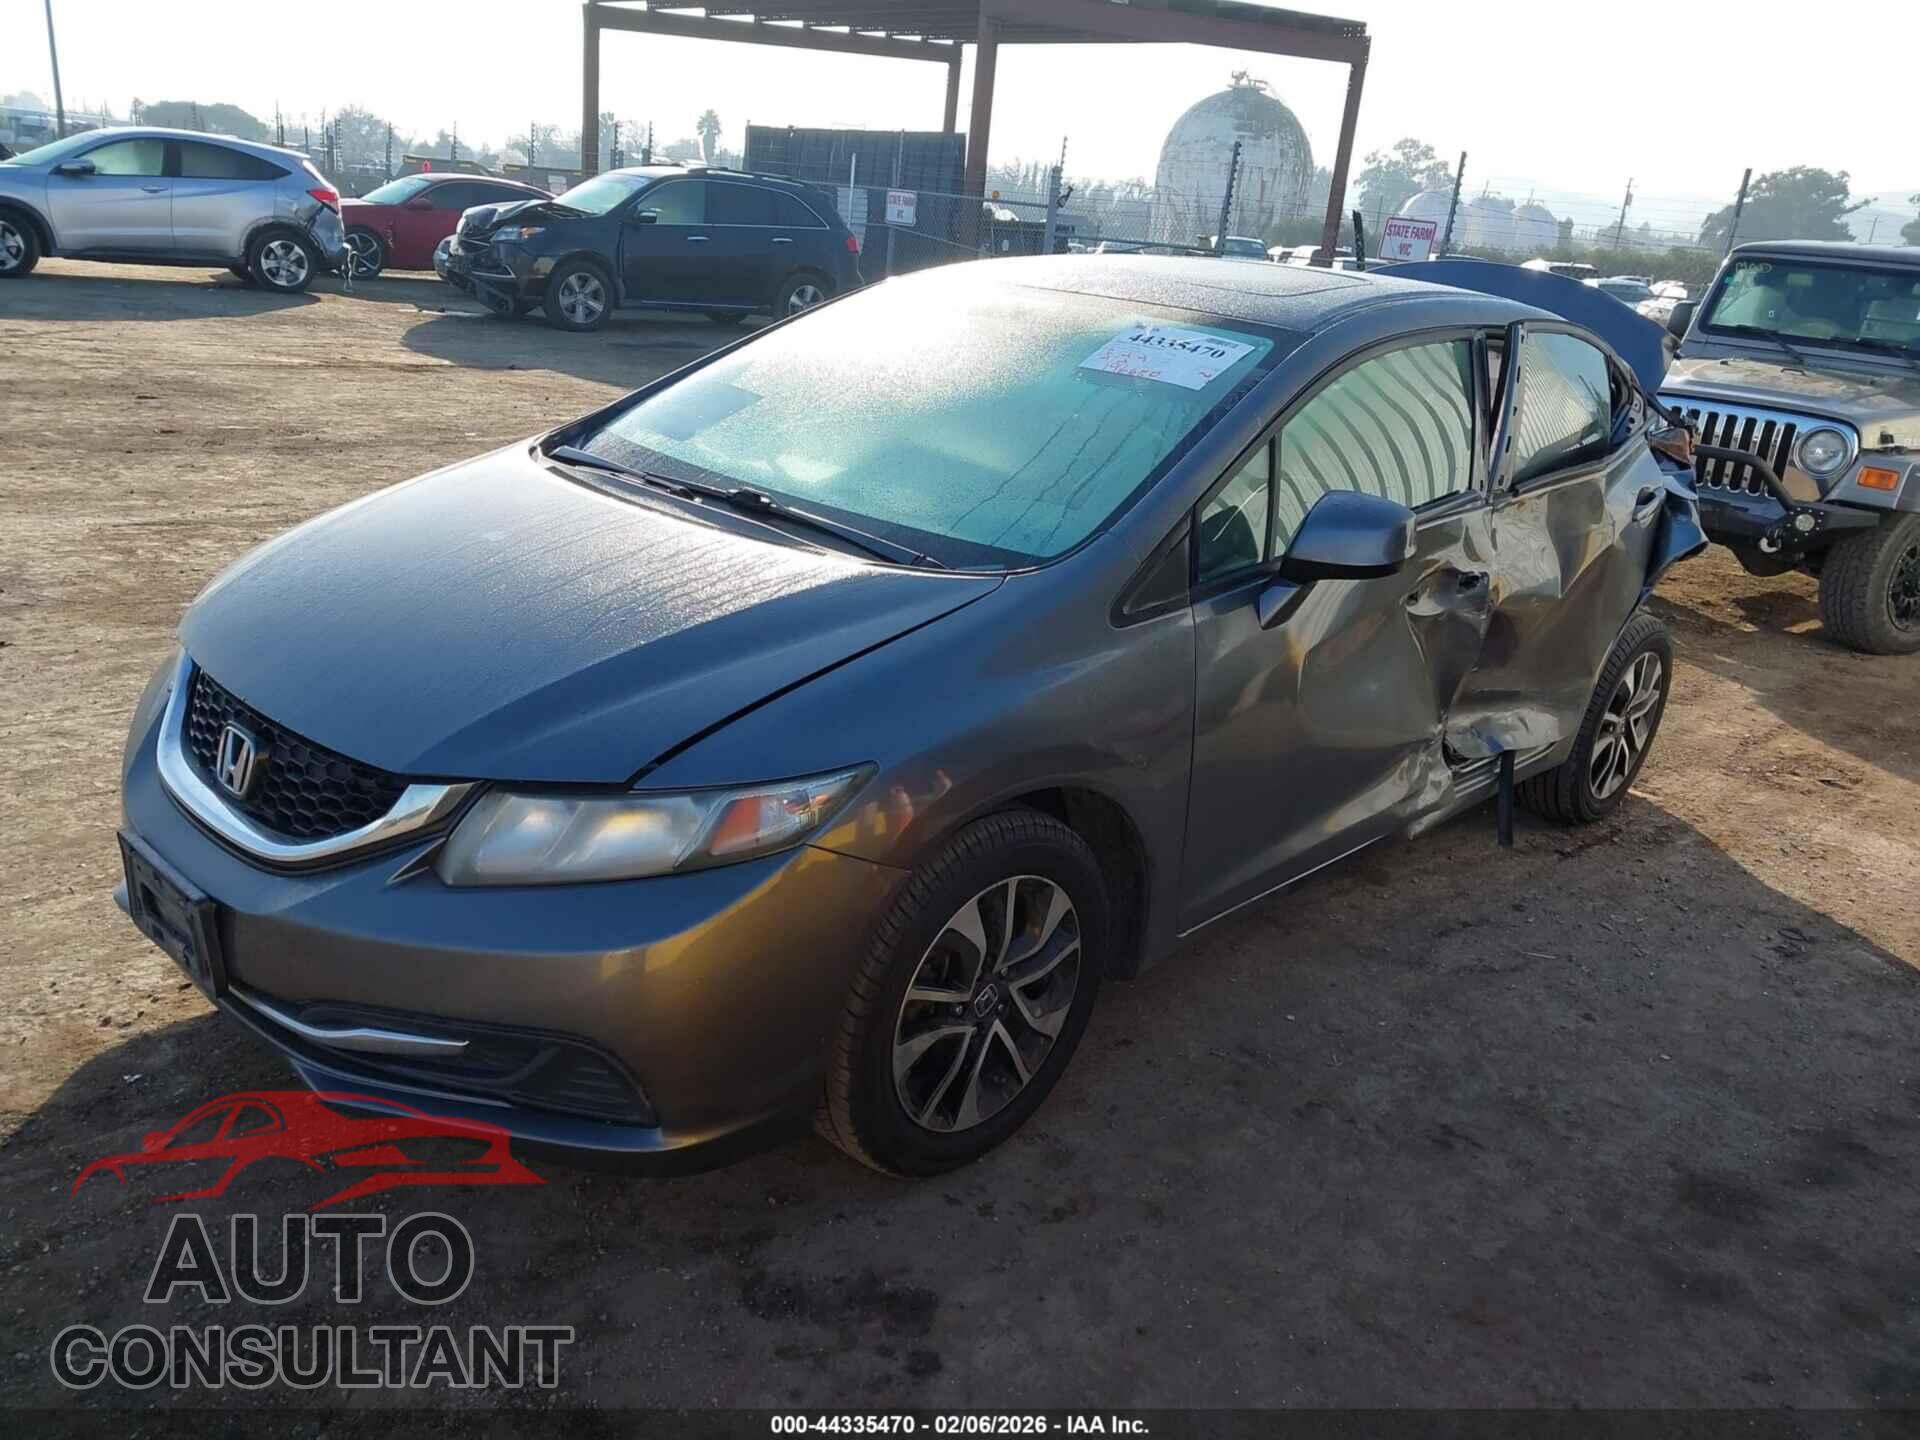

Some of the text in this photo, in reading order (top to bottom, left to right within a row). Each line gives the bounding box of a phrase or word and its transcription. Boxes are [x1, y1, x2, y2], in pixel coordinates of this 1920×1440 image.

[1386, 224, 1434, 241] STATE FARM
[1129, 334, 1226, 359] 44335470
